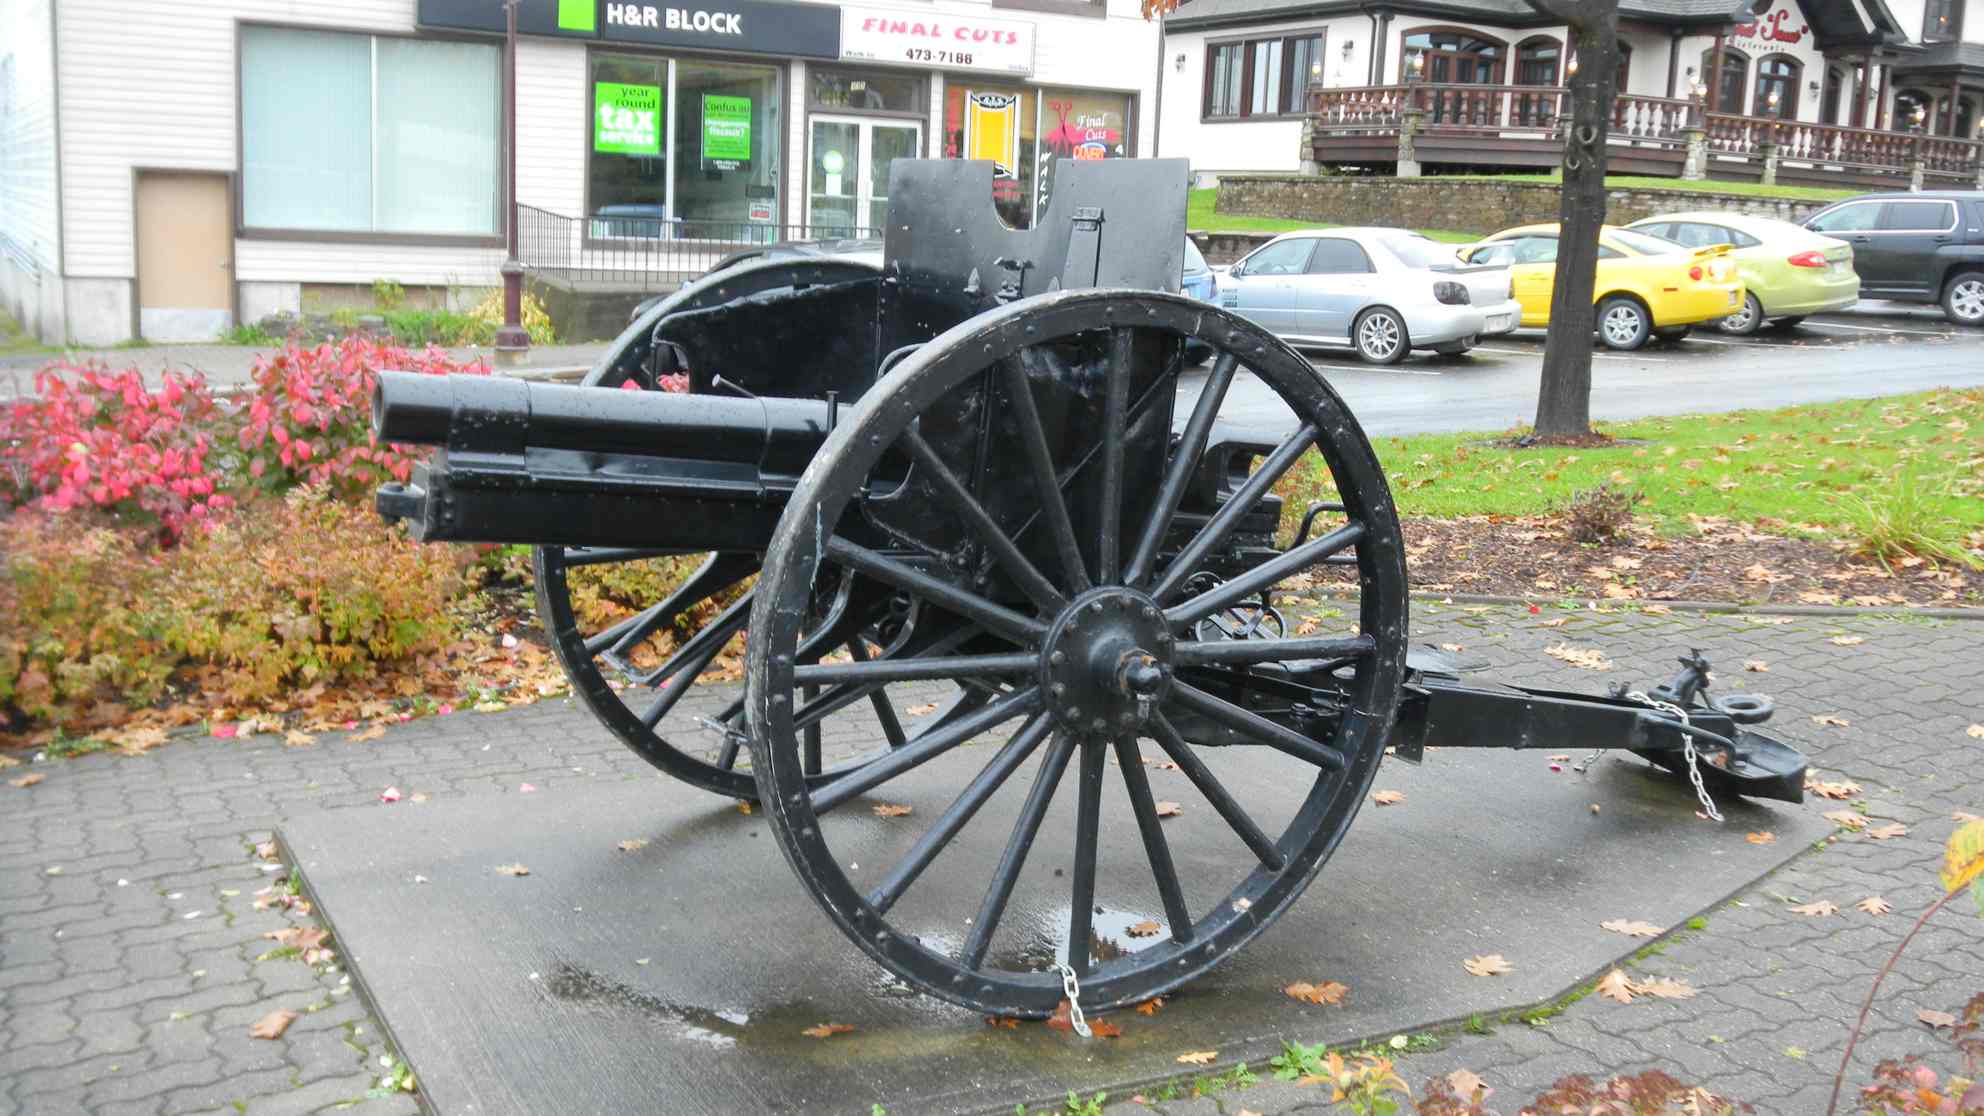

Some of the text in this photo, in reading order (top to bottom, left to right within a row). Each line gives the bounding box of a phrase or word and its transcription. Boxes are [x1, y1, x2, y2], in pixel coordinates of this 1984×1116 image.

[607, 3, 742, 34] H&R BLOCK
[862, 17, 1018, 45] FINAL CUTS
[616, 99, 656, 109] round
[622, 88, 649, 98] year
[599, 103, 655, 131] tax
[1076, 112, 1105, 130] Final
